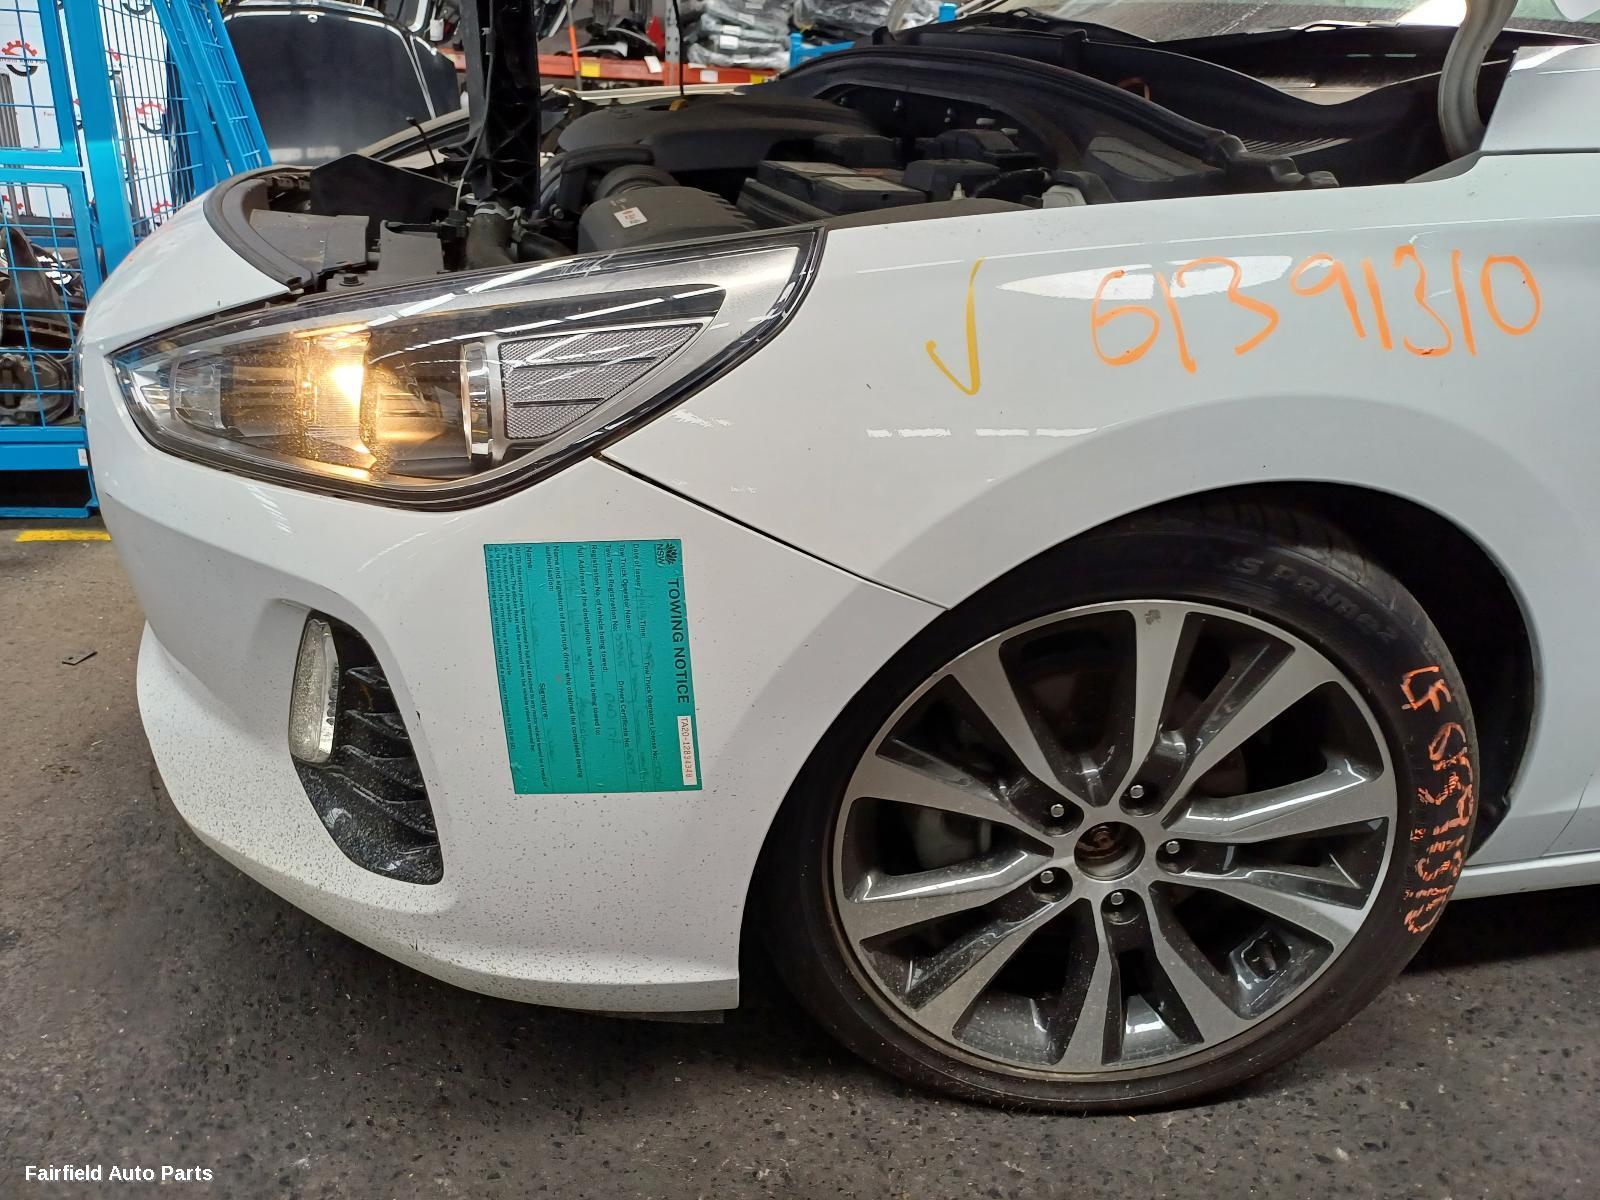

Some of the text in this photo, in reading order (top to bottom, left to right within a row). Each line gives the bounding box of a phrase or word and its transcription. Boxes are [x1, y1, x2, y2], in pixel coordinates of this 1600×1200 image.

[656, 543, 664, 564] NSW
[667, 577, 689, 703] TOWING NOTICE
[538, 682, 549, 720] Signature:
